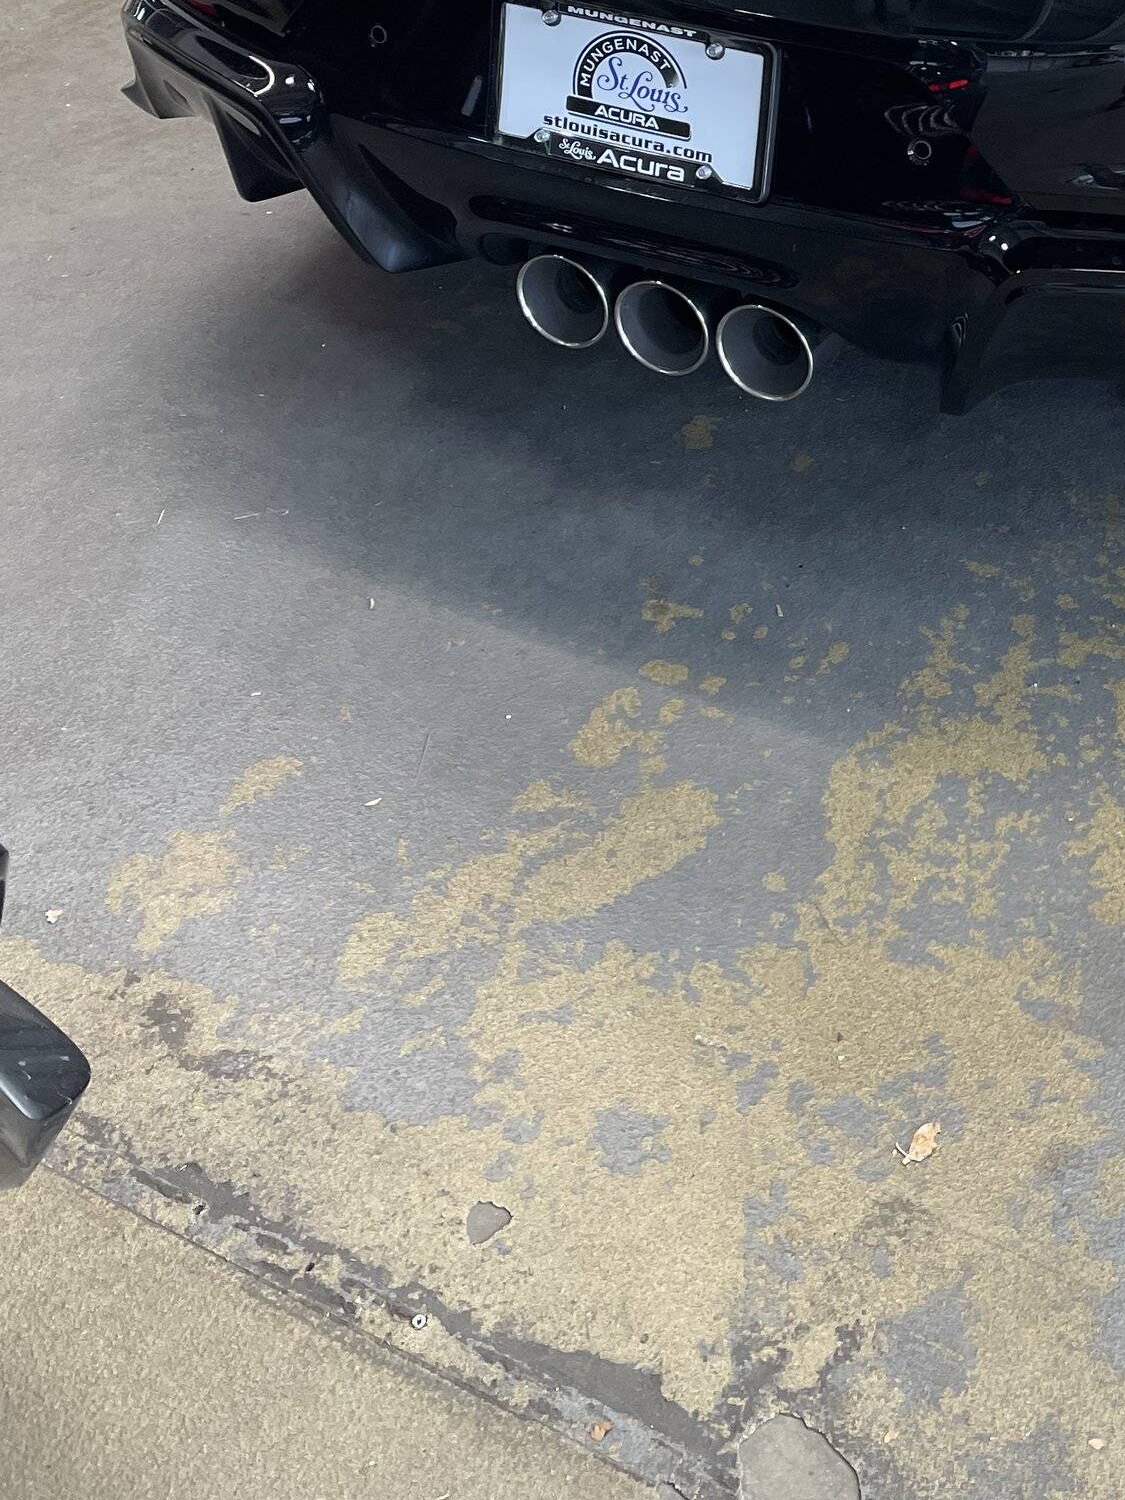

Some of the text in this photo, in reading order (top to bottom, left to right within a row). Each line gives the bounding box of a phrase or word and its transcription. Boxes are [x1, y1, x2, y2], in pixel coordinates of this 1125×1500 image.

[567, 5, 697, 38] MUNGENAST
[579, 38, 671, 88] MUNGENAST
[617, 70, 689, 113] Louis
[594, 105, 660, 130] ACURA
[543, 114, 713, 163] stlouisacura.com
[596, 148, 685, 183] Acura
